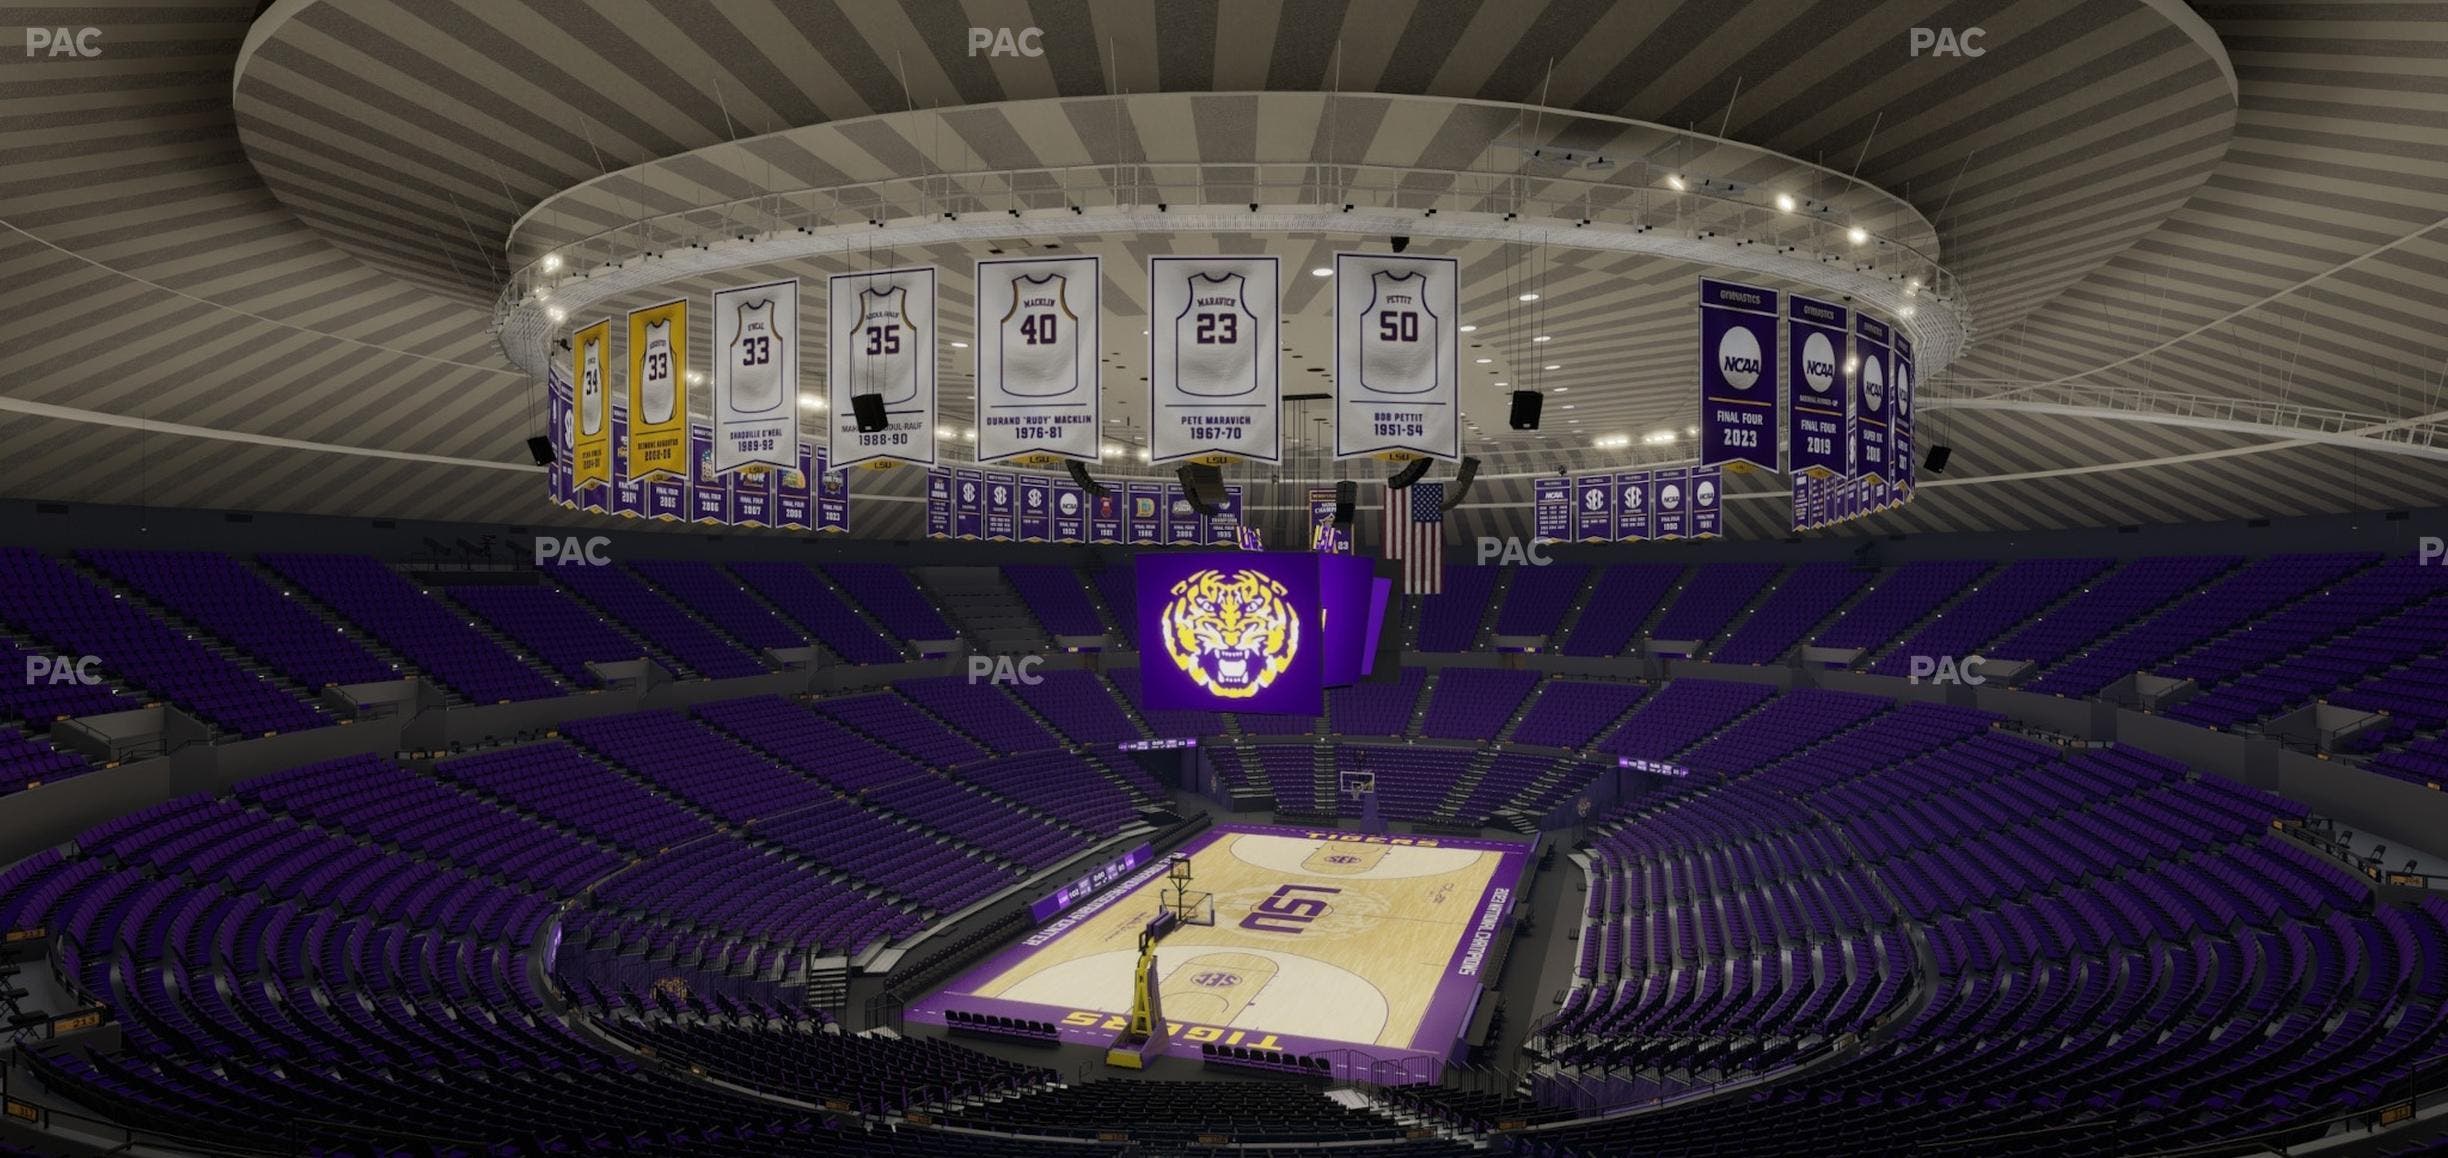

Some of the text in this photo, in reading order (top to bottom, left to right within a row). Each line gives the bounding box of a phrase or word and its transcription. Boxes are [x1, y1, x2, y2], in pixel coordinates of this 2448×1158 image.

[1197, 297, 1236, 308] MARAVICH
[1719, 289, 1761, 305] GYMNASTICS
[1020, 314, 1057, 345] 40
[1197, 313, 1237, 344] 23
[1380, 310, 1418, 342] 50
[866, 325, 900, 355] 35
[742, 336, 769, 366] 33
[649, 352, 668, 381] 33
[1724, 356, 1760, 376] NCAA
[1806, 360, 1834, 378] NCAA
[586, 368, 598, 395] 34
[1865, 381, 1882, 398] NCAA
[986, 416, 1020, 426] DURAND
[1054, 414, 1092, 424] MACKLIN
[1181, 416, 1251, 425] PETE MARAVICH
[1374, 412, 1423, 422] BOB PETTIT
[1717, 410, 1763, 426] FINAL FOUR
[1015, 426, 1063, 439] 1976-81
[1190, 427, 1242, 440] 1967-70
[1374, 423, 1423, 437] 1951-54
[1801, 419, 1837, 434] FINAL FOUR
[738, 439, 774, 453] 1989-92
[858, 432, 908, 446] 1988-90
[1724, 428, 1757, 448] 2023
[1807, 436, 1831, 455] 2019
[1029, 455, 1050, 464] LSU
[1206, 455, 1227, 464] LSU
[1585, 488, 1604, 511] SEC
[1624, 486, 1642, 509] SEC
[1306, 832, 1440, 848] TIGERS
[1327, 854, 1359, 864] SEC
[1239, 884, 1342, 935] LSU
[1195, 972, 1238, 987] SEC
[72, 1016, 96, 1028] 213
